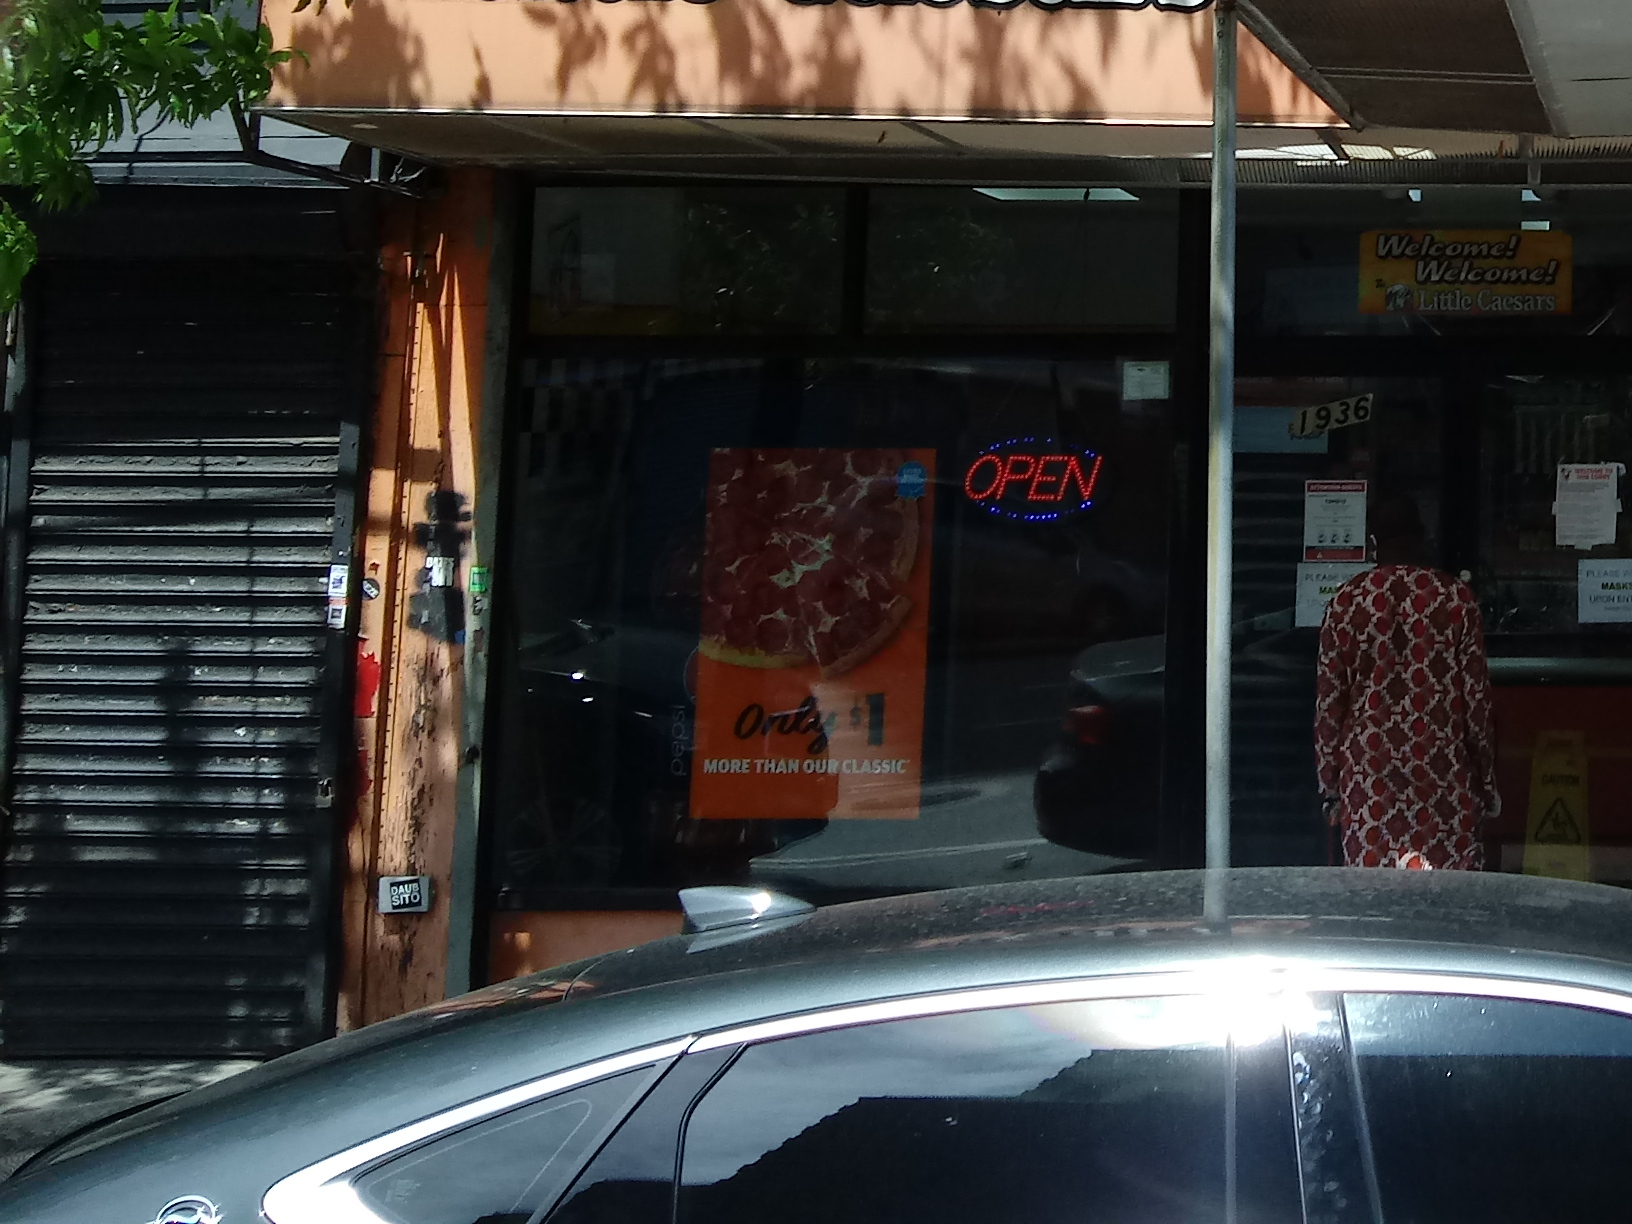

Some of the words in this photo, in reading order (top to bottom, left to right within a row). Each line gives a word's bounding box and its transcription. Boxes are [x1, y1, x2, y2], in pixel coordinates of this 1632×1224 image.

[1376, 233, 1521, 260] Welcome!
[1415, 258, 1560, 286] Welcome!
[1418, 288, 1473, 312] Little
[1477, 288, 1557, 312] Caesars
[1299, 395, 1371, 436] 1936
[963, 454, 1103, 502] OPEN
[733, 695, 837, 754] Only
[704, 759, 751, 774] MORE
[754, 759, 800, 774] THAN
[803, 759, 838, 774] OUR
[391, 883, 419, 895] DAUB
[392, 892, 420, 906] SITO
